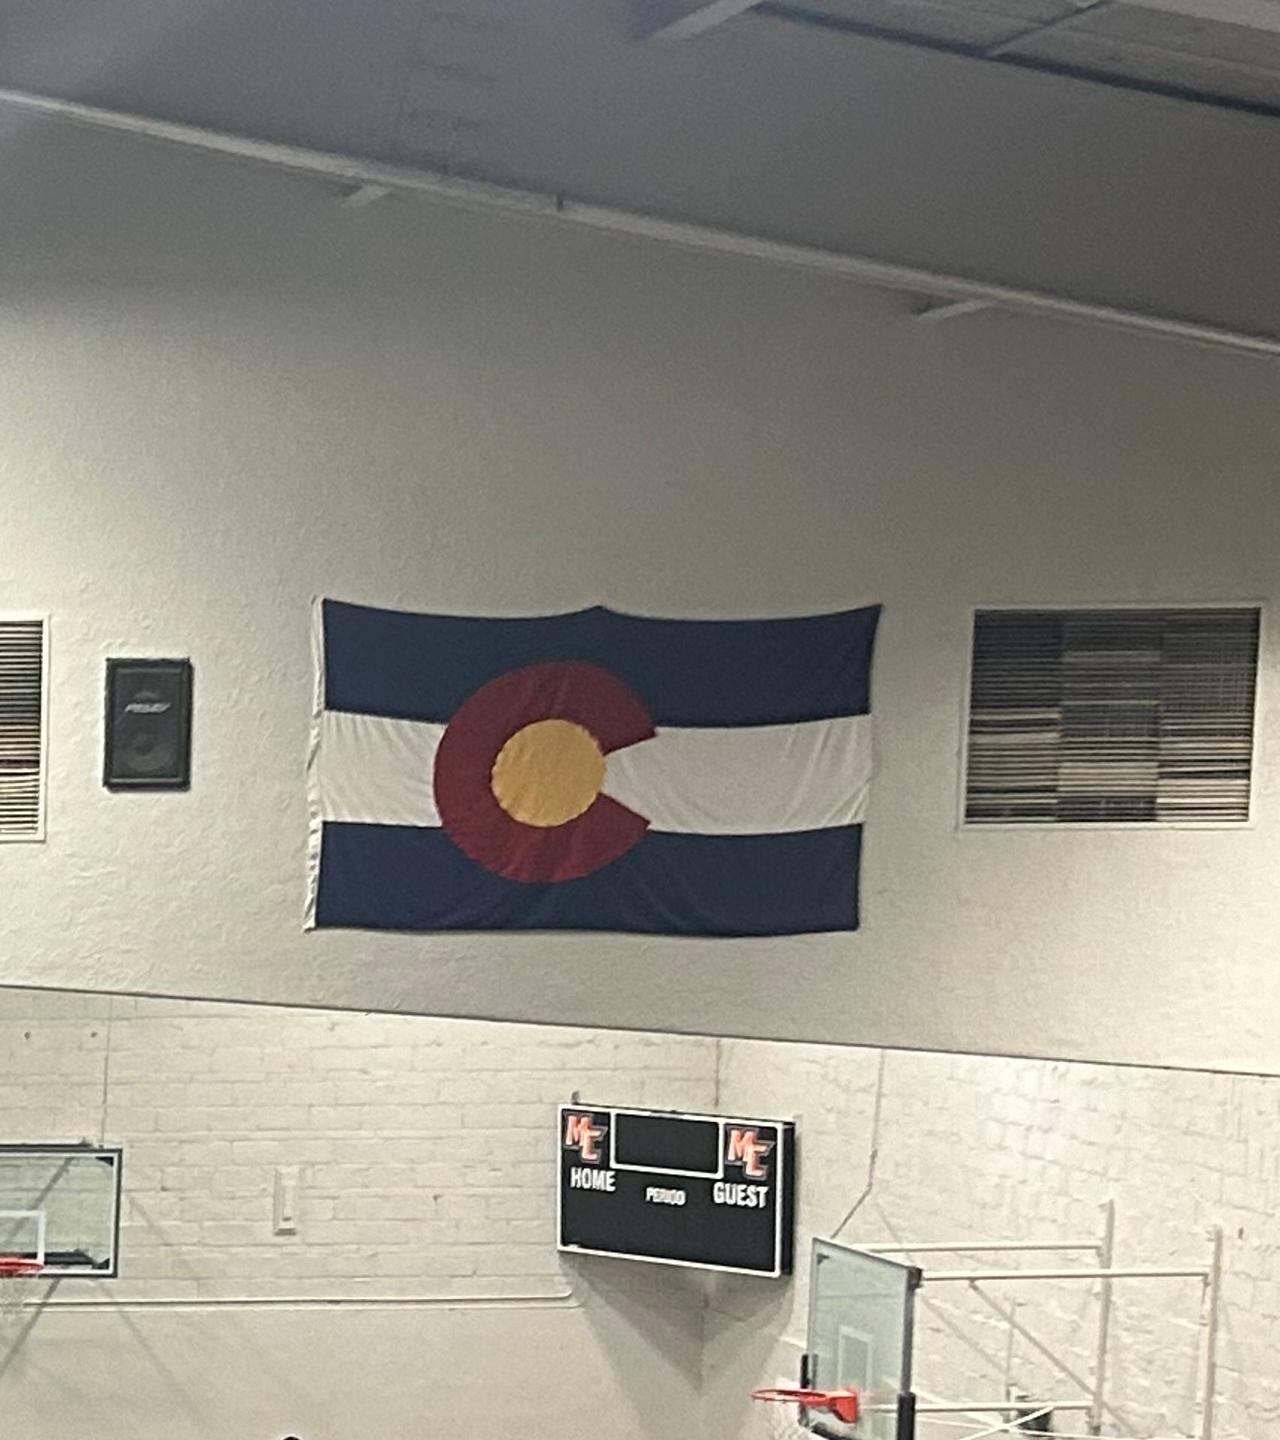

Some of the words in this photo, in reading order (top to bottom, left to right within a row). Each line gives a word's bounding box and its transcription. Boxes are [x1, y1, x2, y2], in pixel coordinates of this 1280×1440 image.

[570, 1166, 616, 1192] HOME
[645, 1186, 687, 1206] PERIOD
[713, 1182, 769, 1209] GUEST
